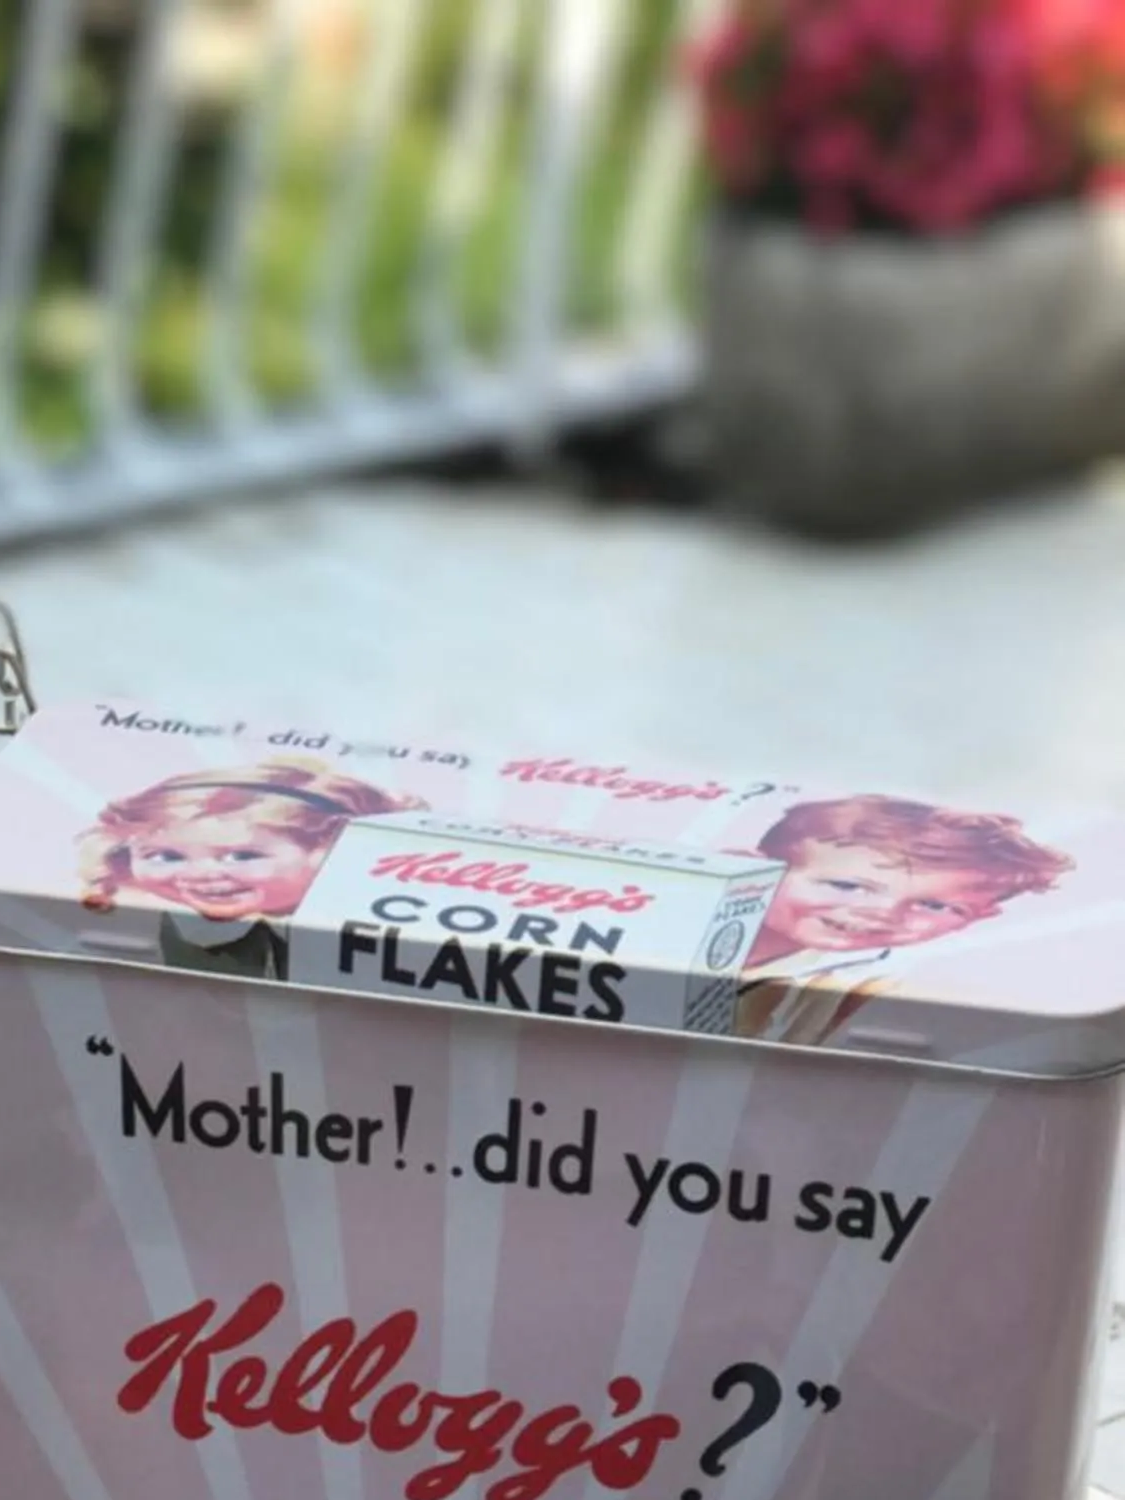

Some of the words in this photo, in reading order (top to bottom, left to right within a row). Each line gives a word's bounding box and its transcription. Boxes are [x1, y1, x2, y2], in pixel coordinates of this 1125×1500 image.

[369, 850, 656, 915] Kellogg's
[369, 894, 627, 956] CORN
[337, 919, 628, 1023] FLAKES
[624, 1150, 771, 1228] you
[794, 1180, 931, 1263] say
